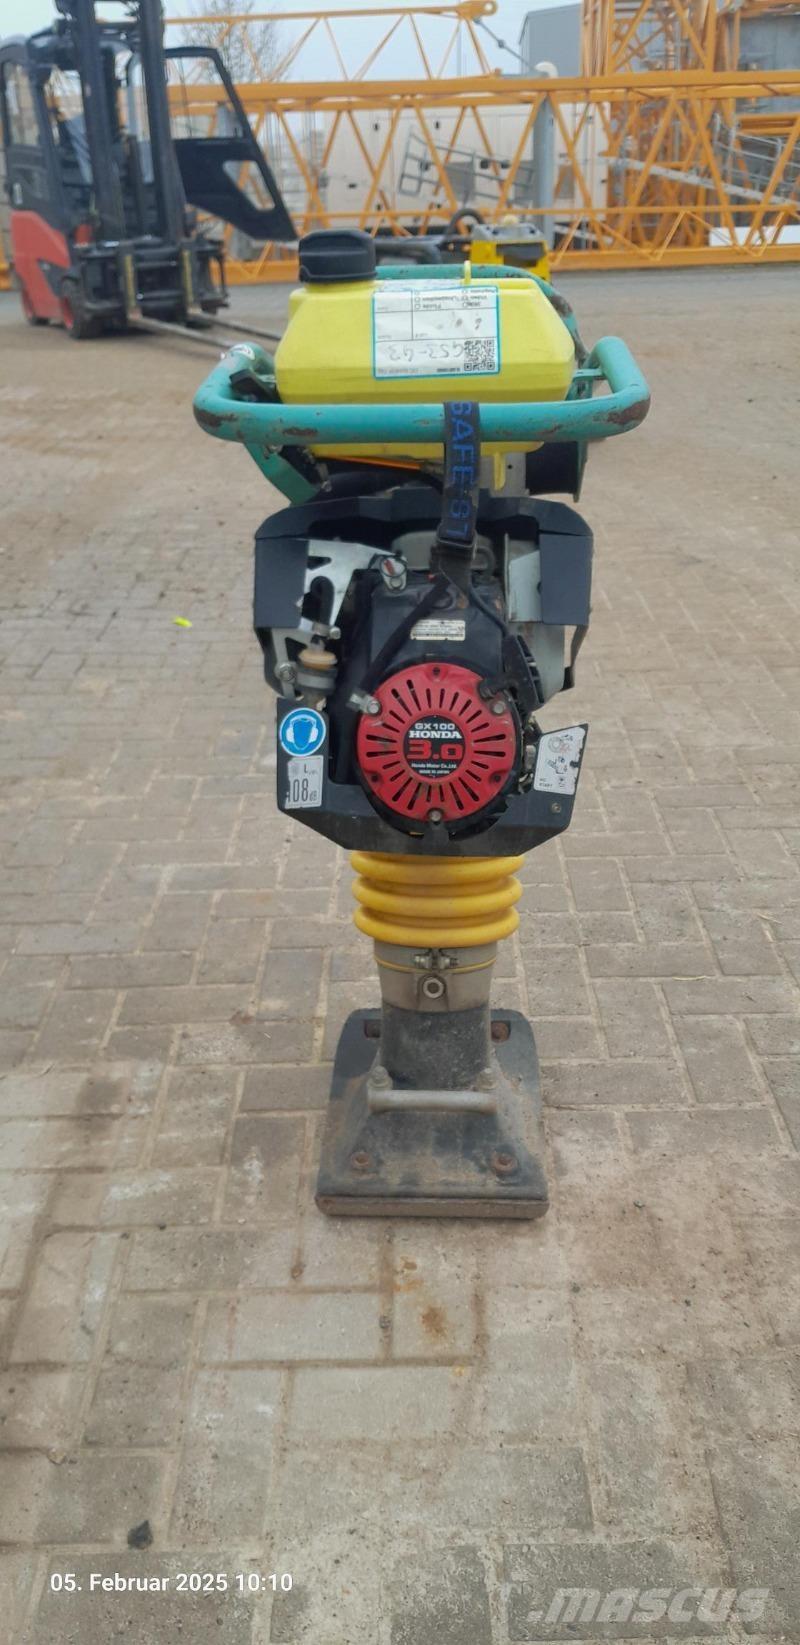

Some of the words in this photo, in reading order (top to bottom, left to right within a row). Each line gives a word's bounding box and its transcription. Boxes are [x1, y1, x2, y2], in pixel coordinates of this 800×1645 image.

[414, 722, 456, 730] GX100
[409, 730, 462, 739] HONDA
[406, 739, 463, 760] 3.0
